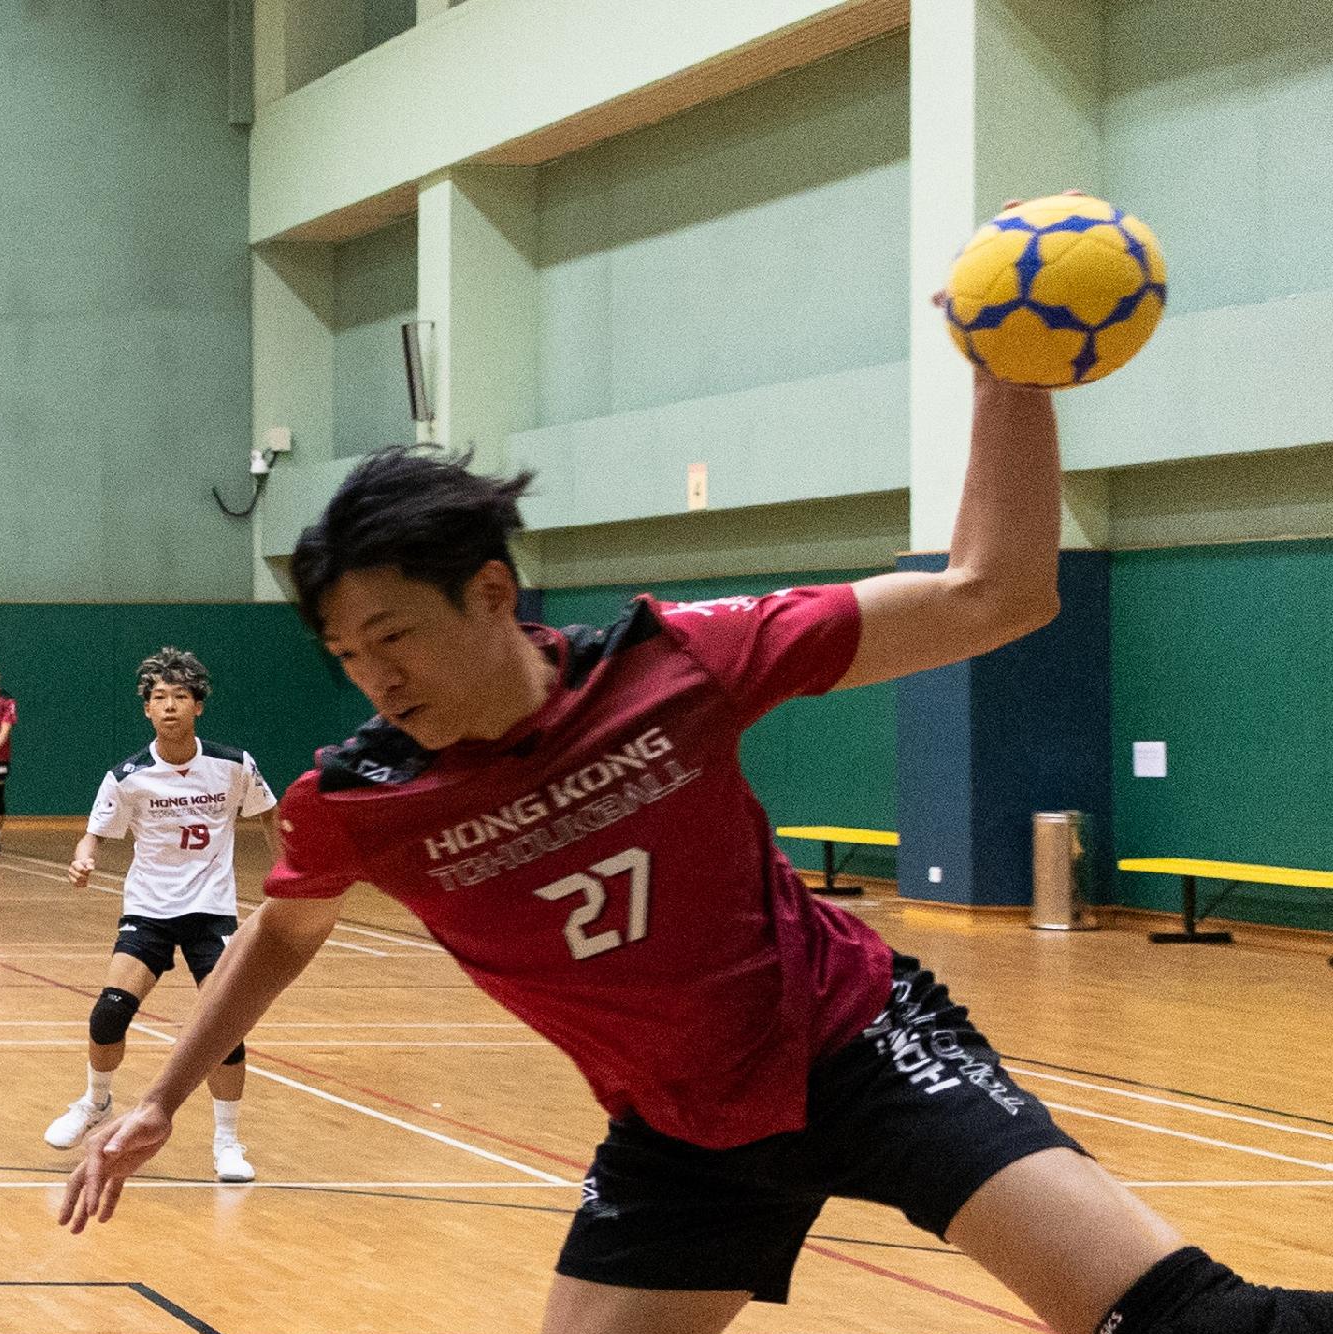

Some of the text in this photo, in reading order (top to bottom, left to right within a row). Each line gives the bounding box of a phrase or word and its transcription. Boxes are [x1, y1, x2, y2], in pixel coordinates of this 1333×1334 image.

[149, 792, 227, 808] HONG KONG
[178, 823, 211, 850] 19
[423, 726, 674, 860] HONG KONG
[426, 760, 703, 893] TCHOUKBALL
[532, 846, 651, 961] 27
